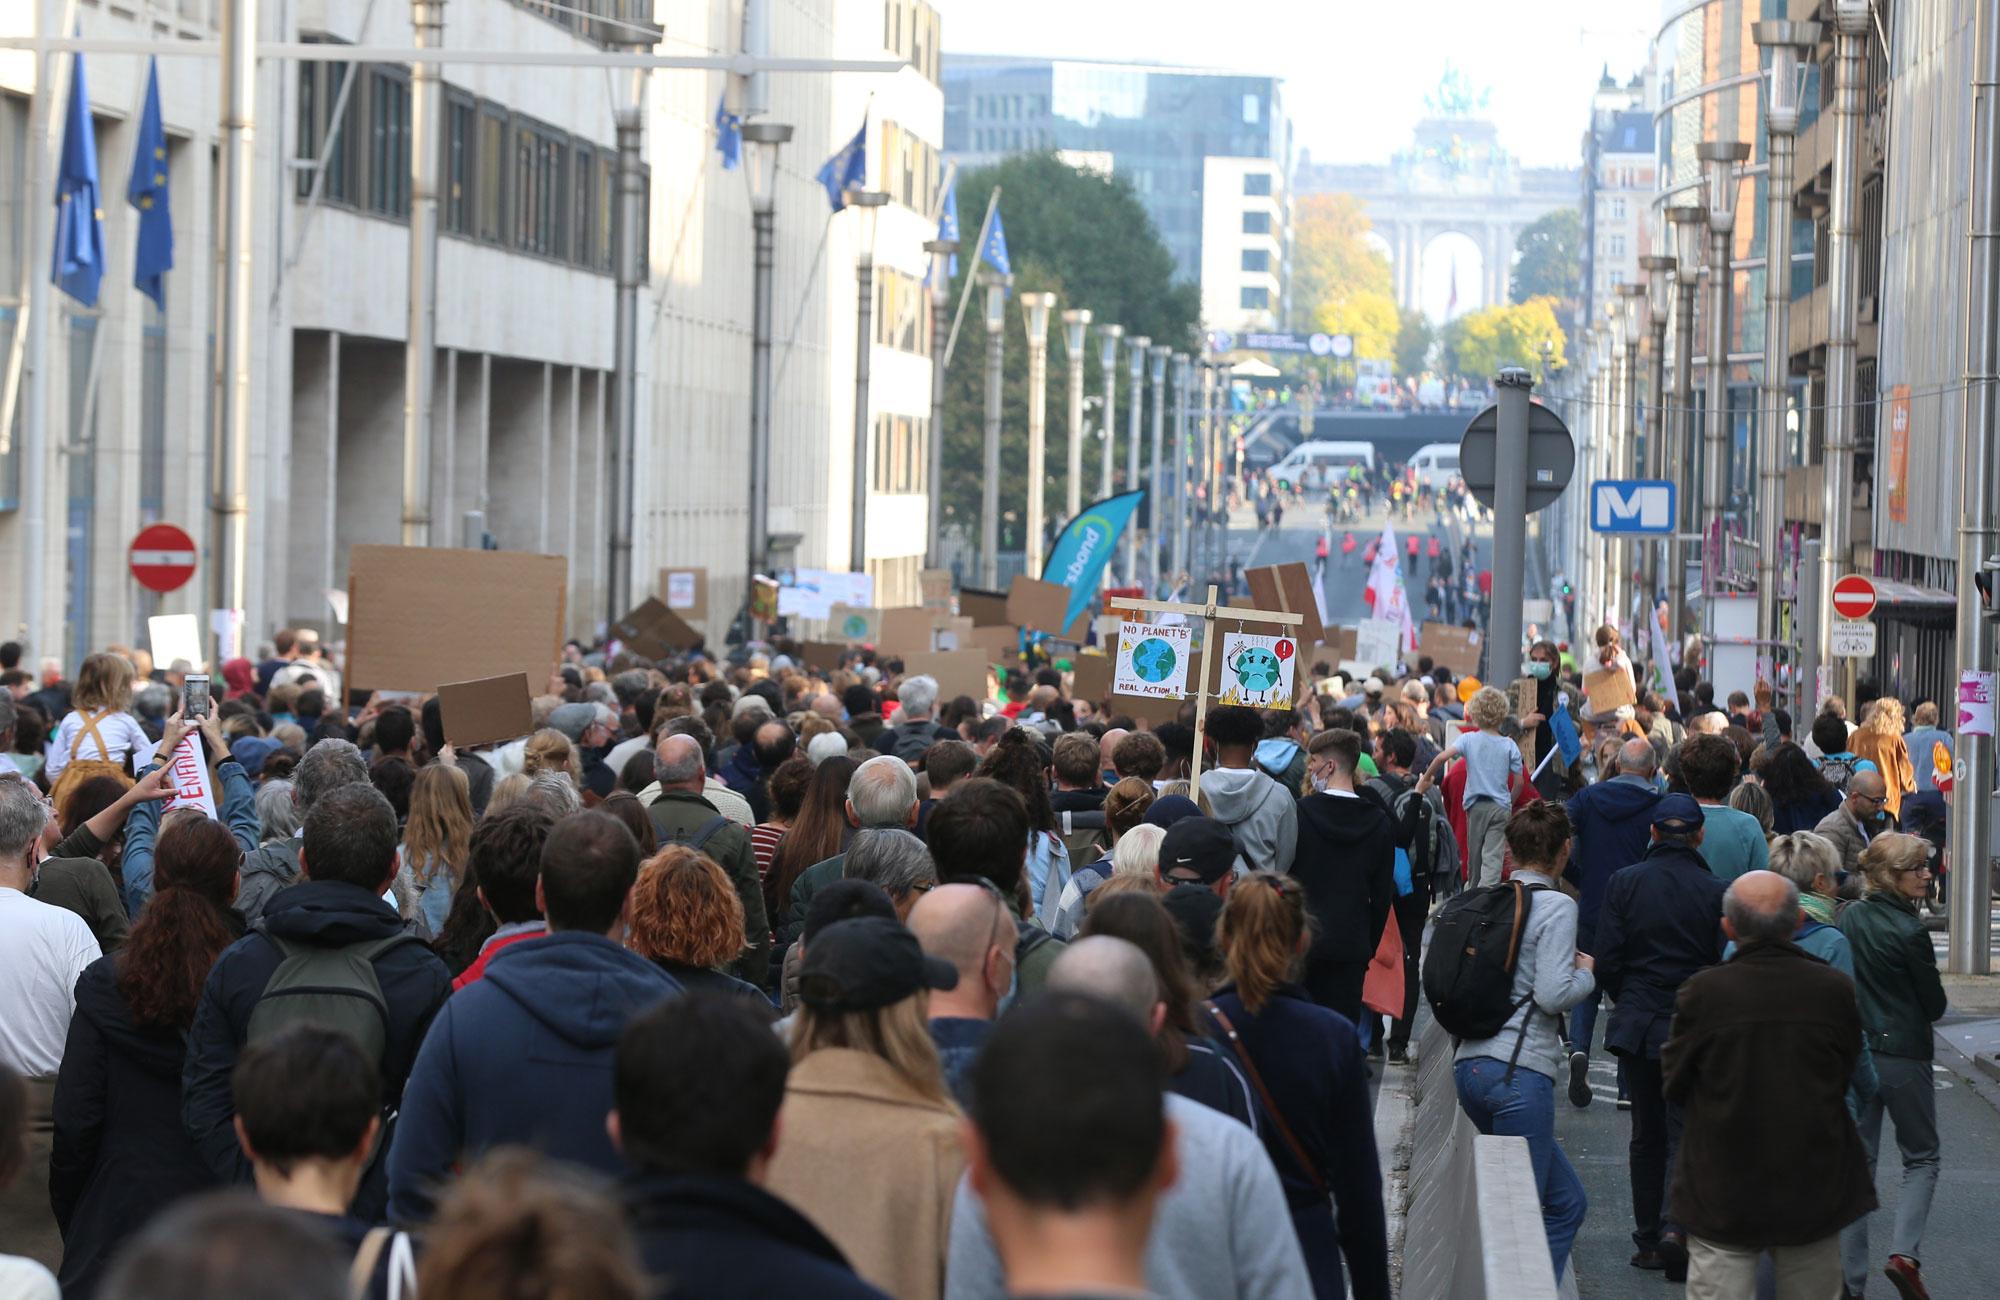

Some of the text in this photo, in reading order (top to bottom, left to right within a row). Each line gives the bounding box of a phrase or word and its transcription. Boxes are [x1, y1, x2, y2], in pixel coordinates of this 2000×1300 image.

[1124, 626, 1137, 635] NO
[1142, 627, 1177, 637] PLANET
[1119, 683, 1140, 691] REAL
[1143, 686, 1170, 694] ACTION
